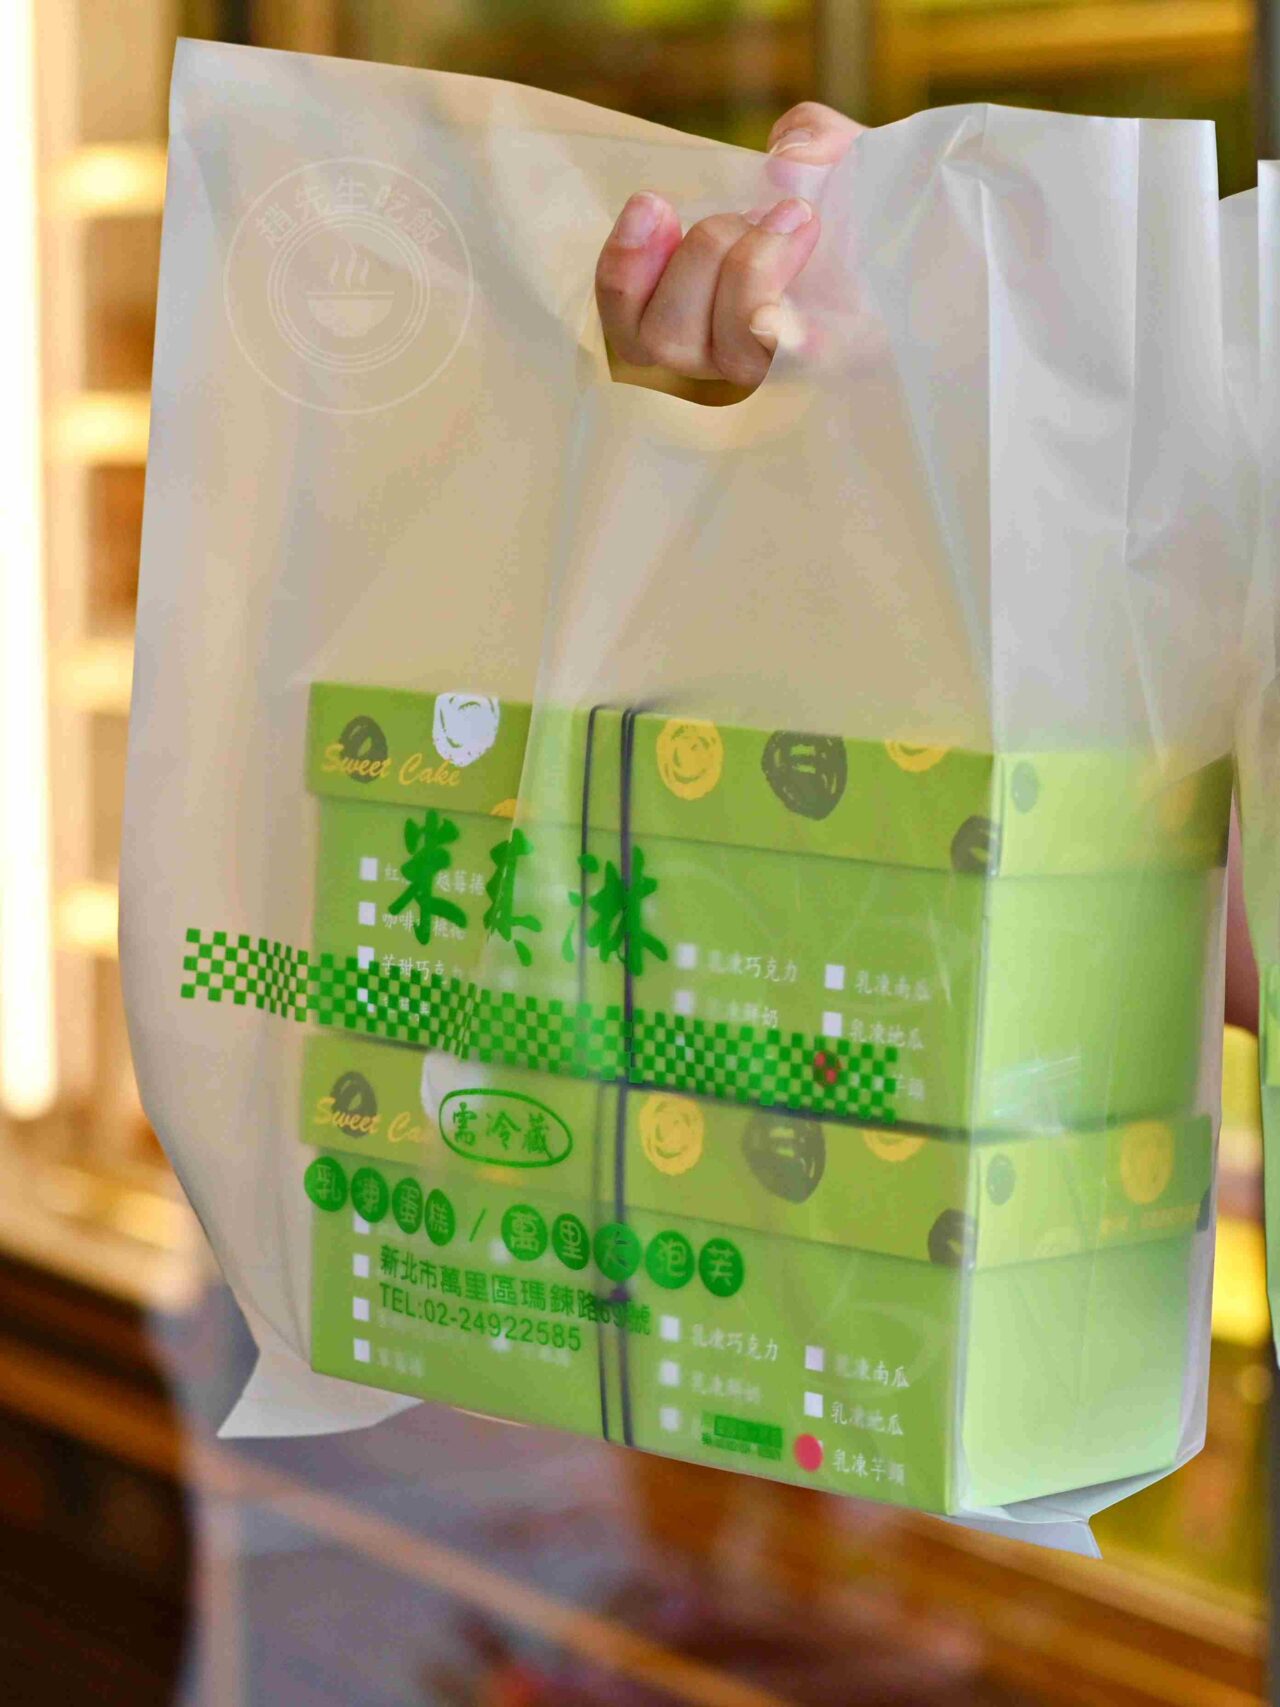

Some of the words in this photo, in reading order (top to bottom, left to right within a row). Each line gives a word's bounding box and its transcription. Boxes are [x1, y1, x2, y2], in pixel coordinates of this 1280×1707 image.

[320, 742, 392, 778] Sweet
[398, 752, 461, 786] Cake
[314, 1096, 382, 1135] Sweet
[452, 1102, 555, 1160] 需冷藏
[379, 1281, 583, 1352] TEL:02-24922585
